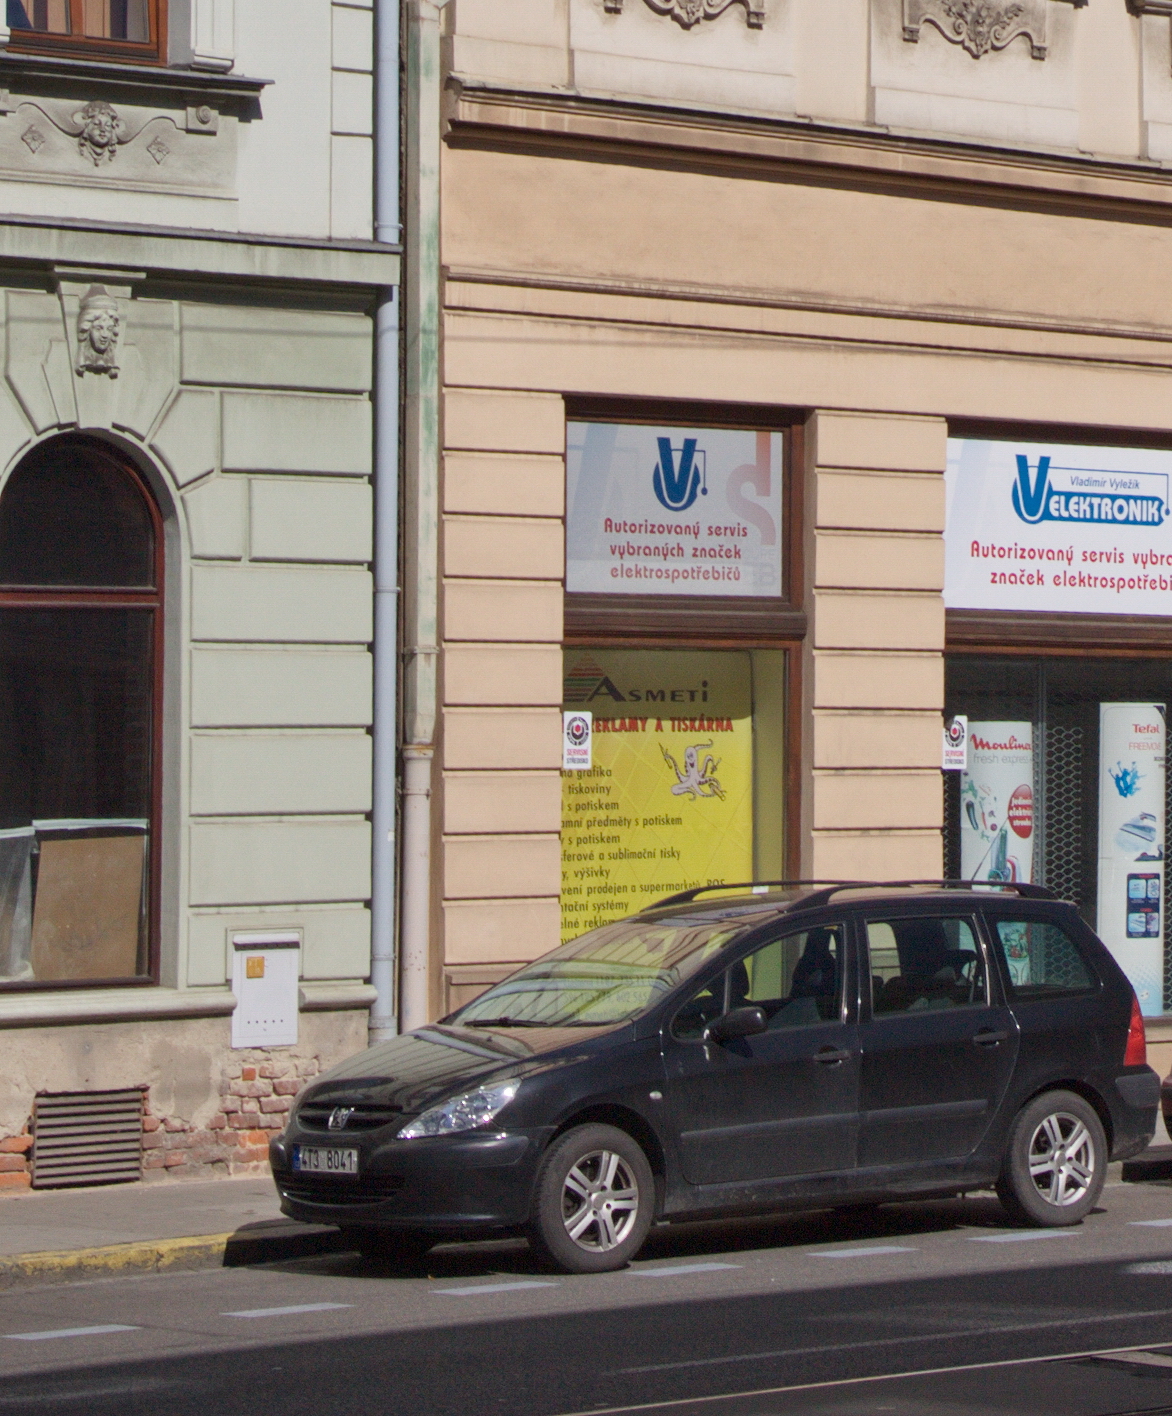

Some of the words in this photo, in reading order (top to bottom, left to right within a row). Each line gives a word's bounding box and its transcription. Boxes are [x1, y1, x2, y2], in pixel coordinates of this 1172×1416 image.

[604, 517, 700, 539] Autorizovaný
[707, 522, 748, 537] servis
[609, 541, 685, 560] vybraných
[692, 544, 742, 559] značek
[971, 540, 1074, 565] Autorizovaný
[1082, 547, 1125, 564] servis
[610, 563, 741, 583] elektrospotřebičů
[990, 569, 1045, 586] značek
[655, 718, 664, 732] A
[670, 713, 734, 732] TISKÁRNA
[1132, 723, 1160, 734] Tefal
[568, 783, 612, 795] tiskoviny
[575, 799, 619, 813] potiskem
[587, 815, 632, 830] předměty
[643, 814, 683, 828] potiskem
[576, 832, 621, 846] potiskem
[608, 847, 656, 861] sublimační
[660, 847, 681, 861] tisky
[574, 866, 611, 880] výšivky
[587, 882, 628, 896] prodejen
[592, 900, 629, 913] systémy
[302, 1148, 319, 1168] 4T3
[327, 1150, 353, 1171] 8041
